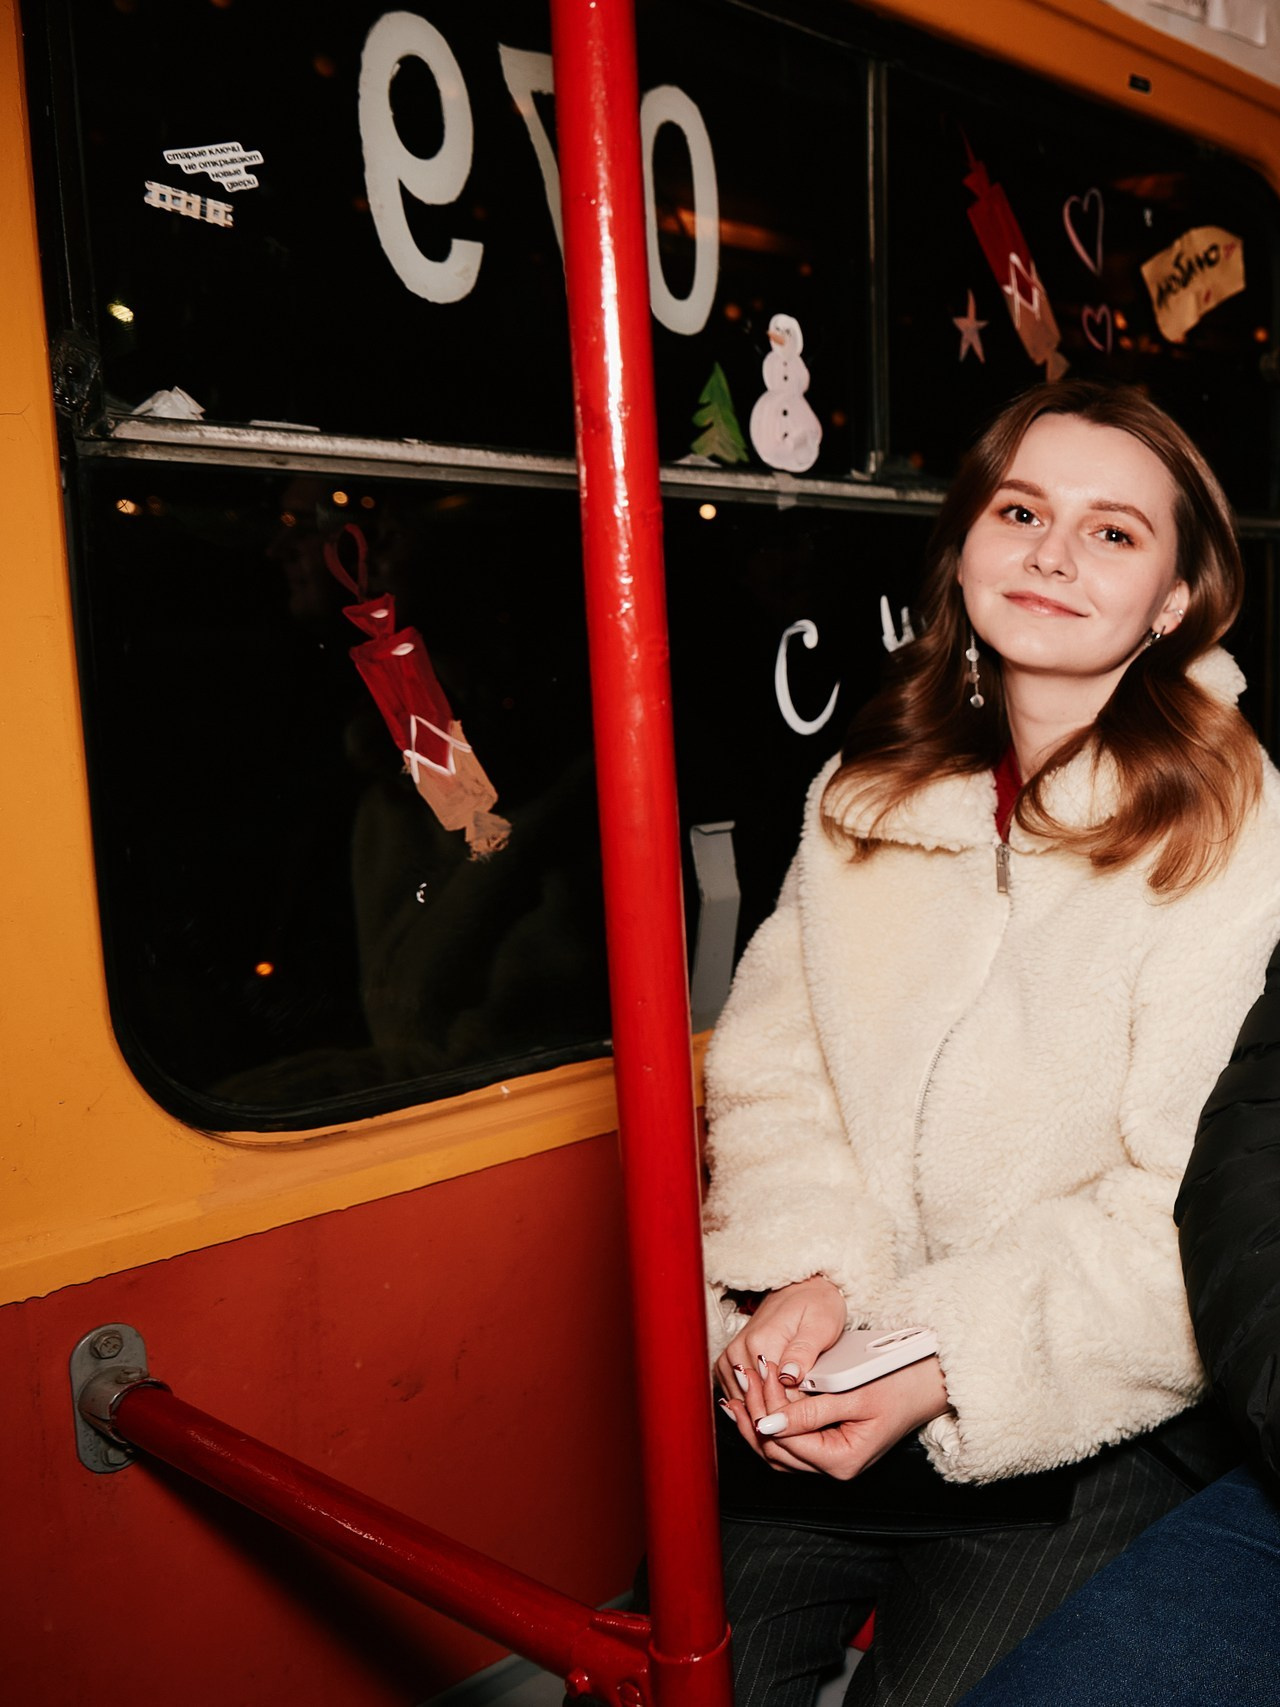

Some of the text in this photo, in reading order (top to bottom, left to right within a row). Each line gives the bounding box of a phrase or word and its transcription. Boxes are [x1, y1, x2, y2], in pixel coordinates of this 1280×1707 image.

[166, 145, 241, 161] старые ключи
[184, 154, 260, 171] не открывают
[211, 169, 242, 179] новые
